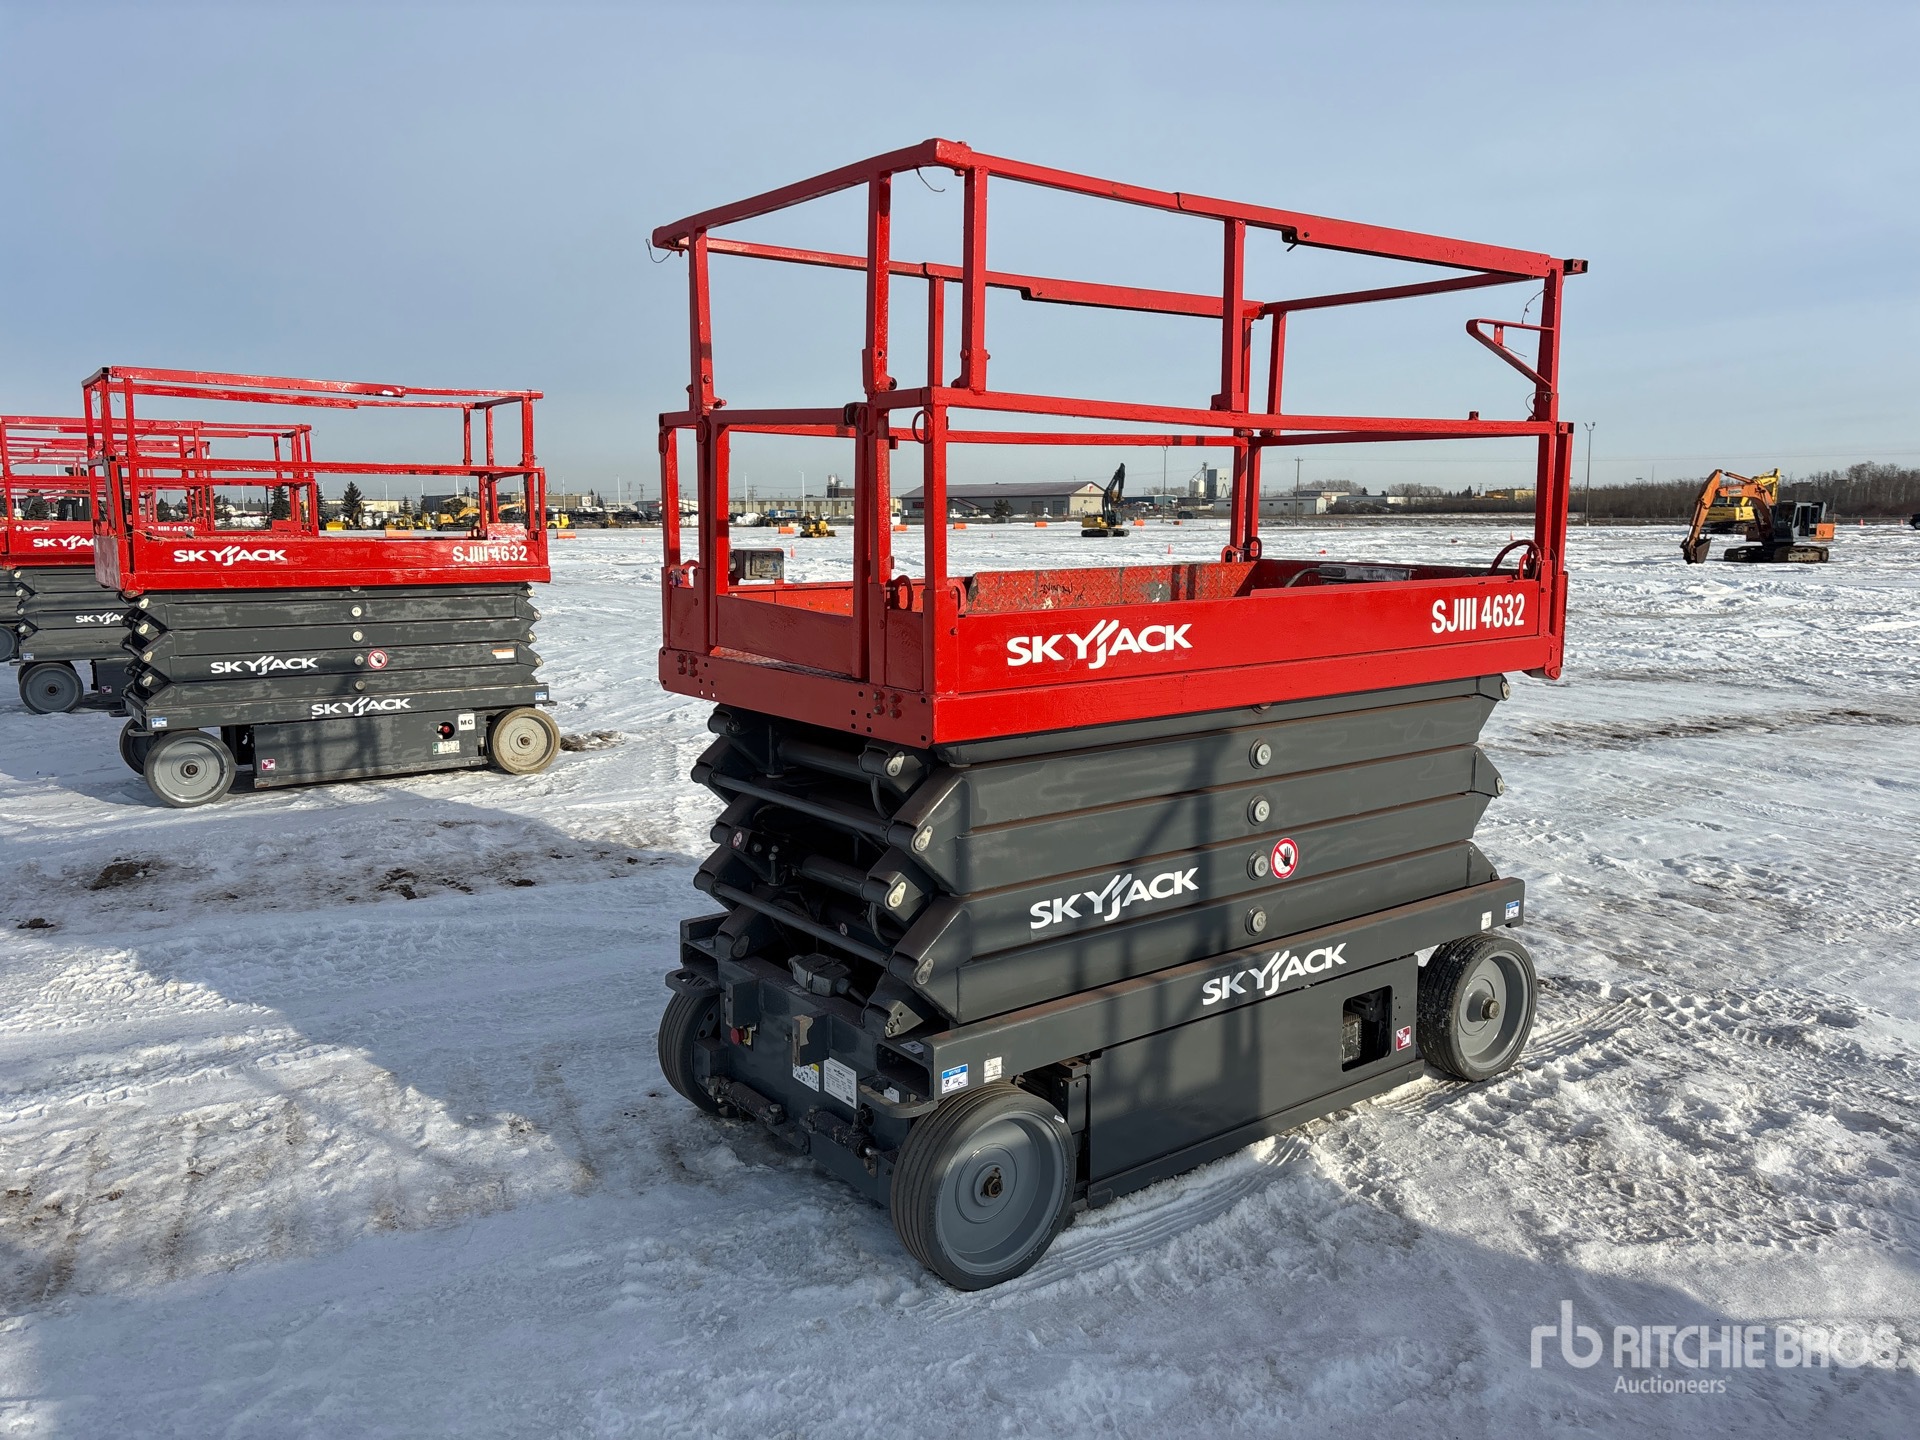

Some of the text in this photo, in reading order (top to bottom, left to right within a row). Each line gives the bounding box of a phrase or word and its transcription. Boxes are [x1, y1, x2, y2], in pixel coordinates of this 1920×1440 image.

[173, 545, 287, 566] SKYJACK
[491, 545, 528, 561] 4632
[75, 612, 124, 625] SKYJA
[1431, 593, 1525, 634] SJIII 4632
[1006, 619, 1193, 669] SKYJACK
[210, 656, 318, 676] SKYJACK
[311, 697, 412, 716] SKYJACK
[1030, 867, 1199, 929] SKYJACK
[1202, 942, 1347, 1005] SKYJACK
